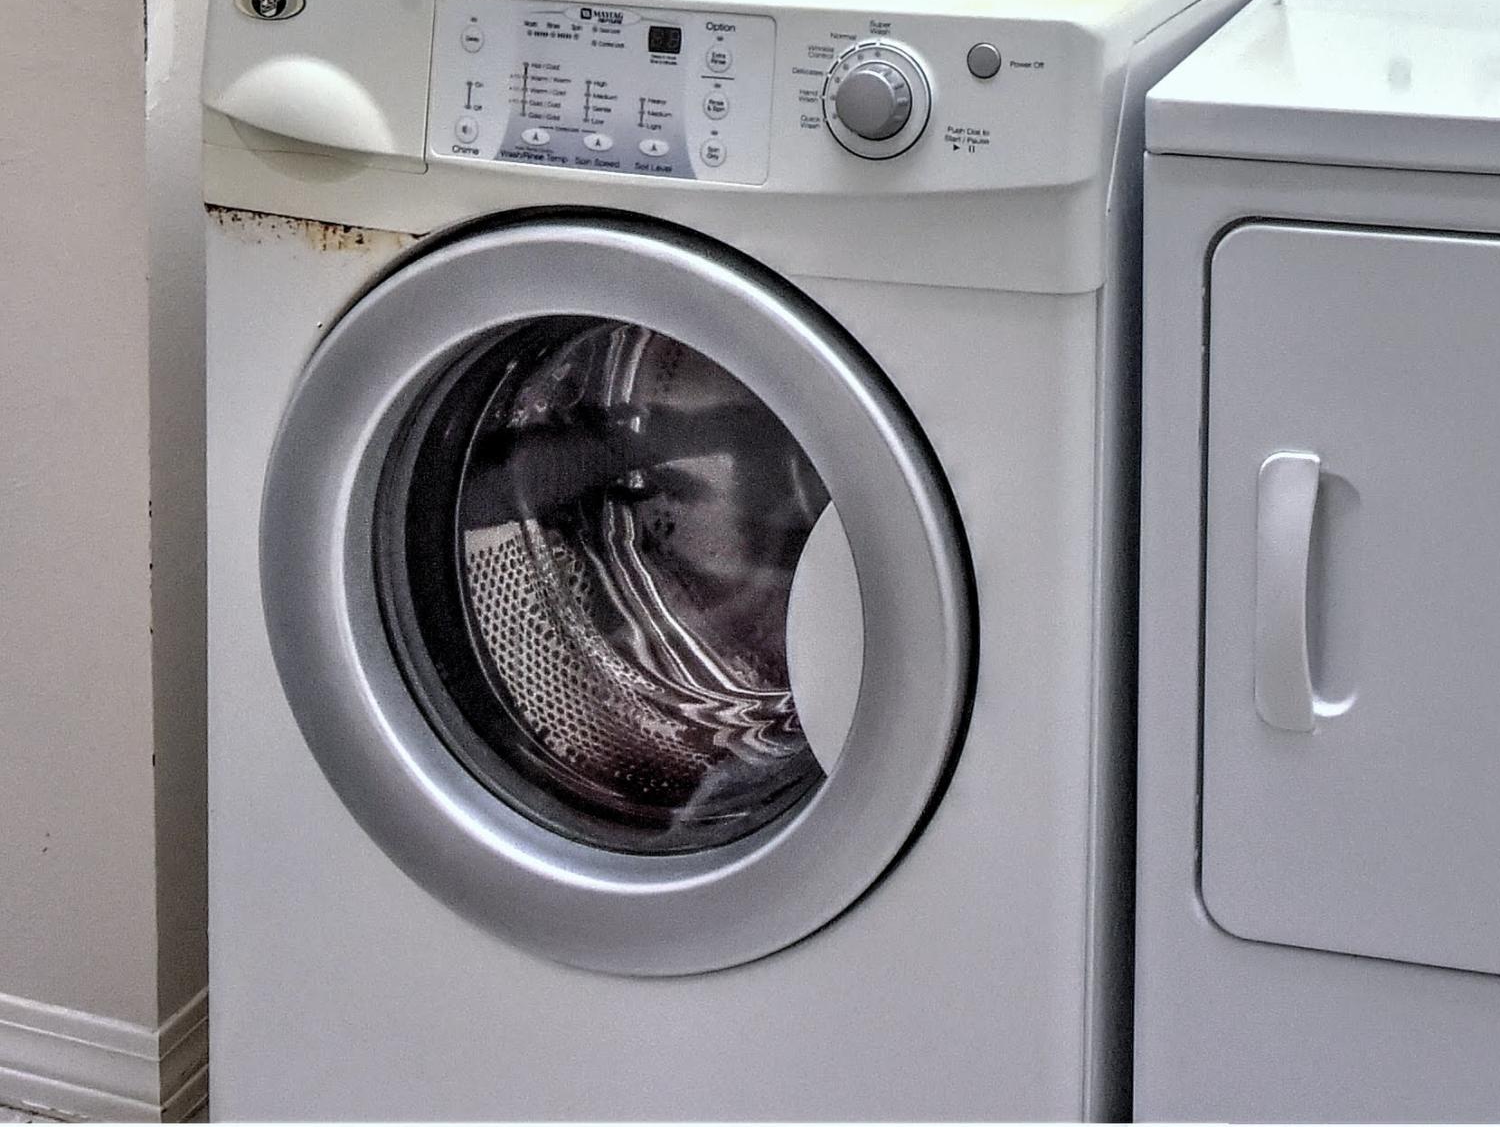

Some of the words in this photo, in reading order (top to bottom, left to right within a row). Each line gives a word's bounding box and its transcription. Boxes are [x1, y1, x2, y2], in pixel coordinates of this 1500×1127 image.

[594, 10, 623, 19] MAYTAG
[706, 22, 736, 32] Option
[1010, 60, 1032, 68] Power
[1033, 61, 1045, 69] Off
[594, 157, 620, 169] Speed
